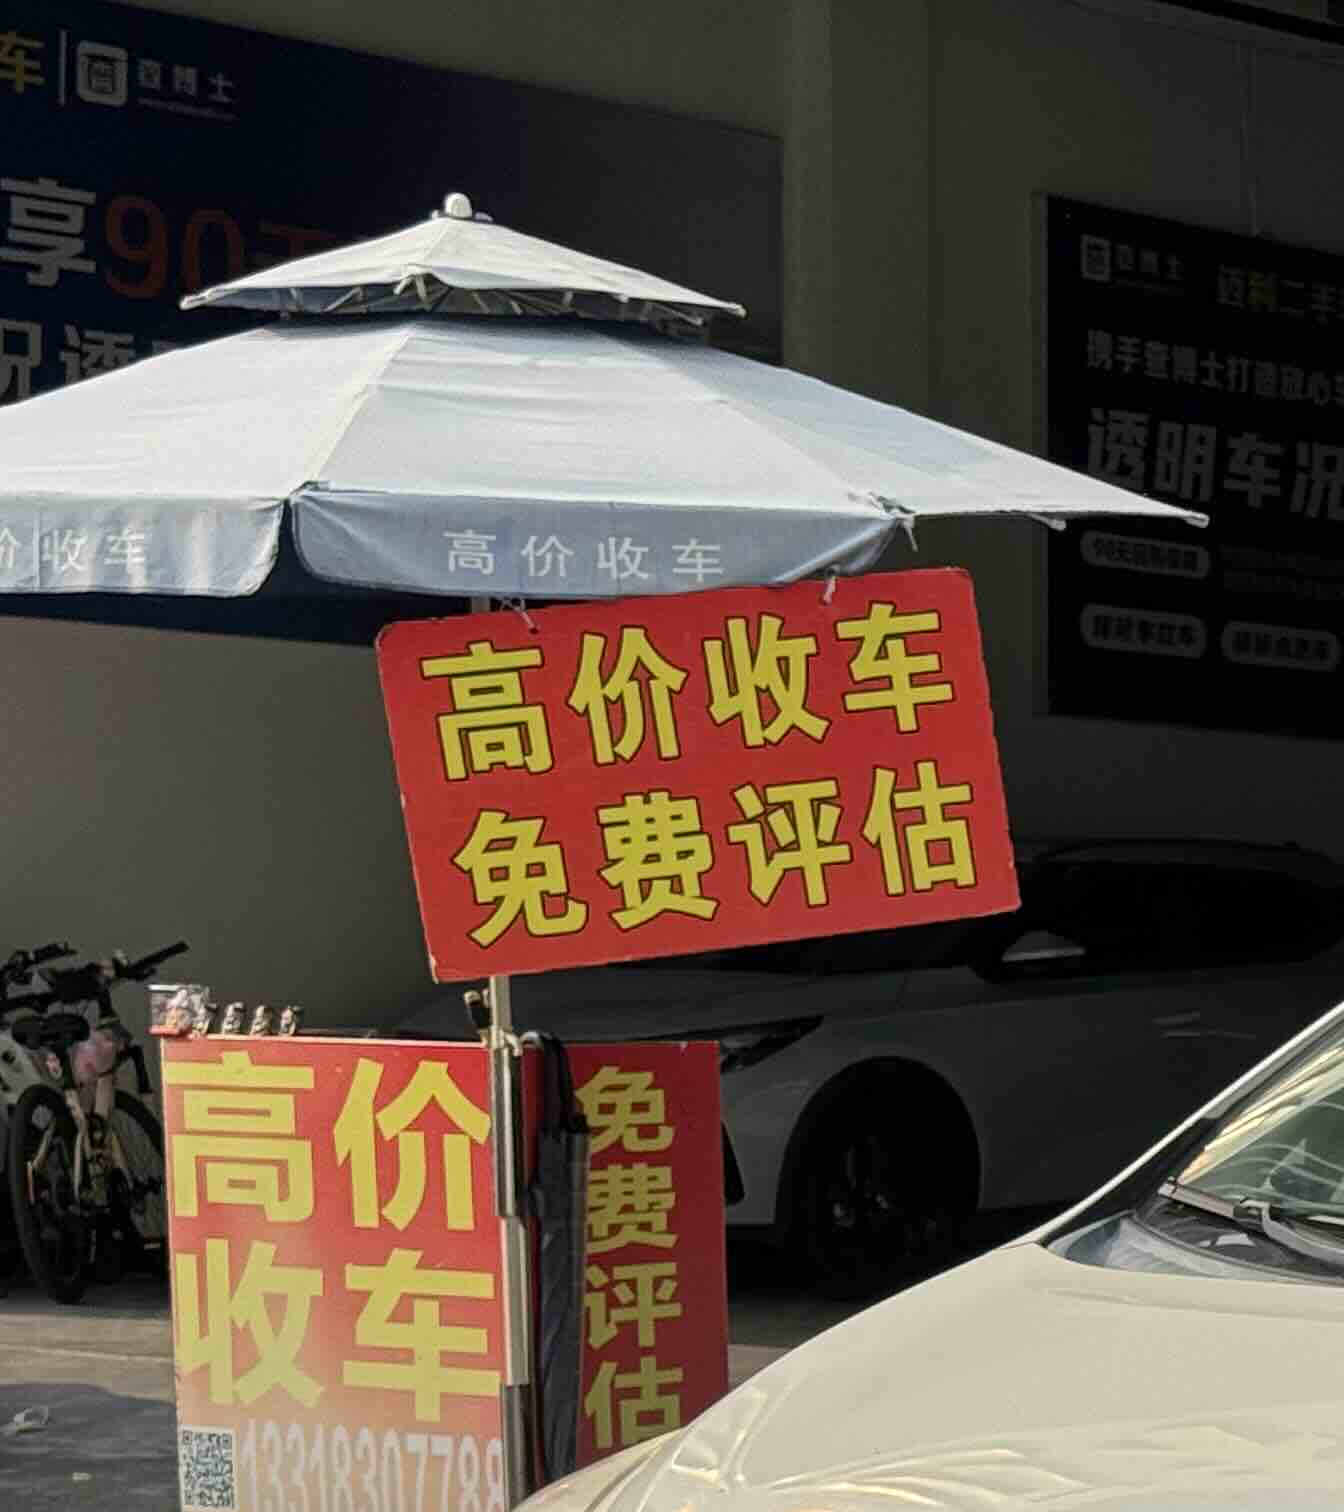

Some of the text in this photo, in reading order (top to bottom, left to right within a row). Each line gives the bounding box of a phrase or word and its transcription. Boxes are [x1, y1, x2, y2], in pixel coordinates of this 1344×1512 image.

[443, 528, 725, 580] 高价收车
[420, 602, 953, 781] 高价收车
[453, 760, 977, 949] 免费评估
[162, 1050, 491, 1231] 高价
[175, 1238, 501, 1423] 收车
[574, 1065, 684, 1449] 免费评估
